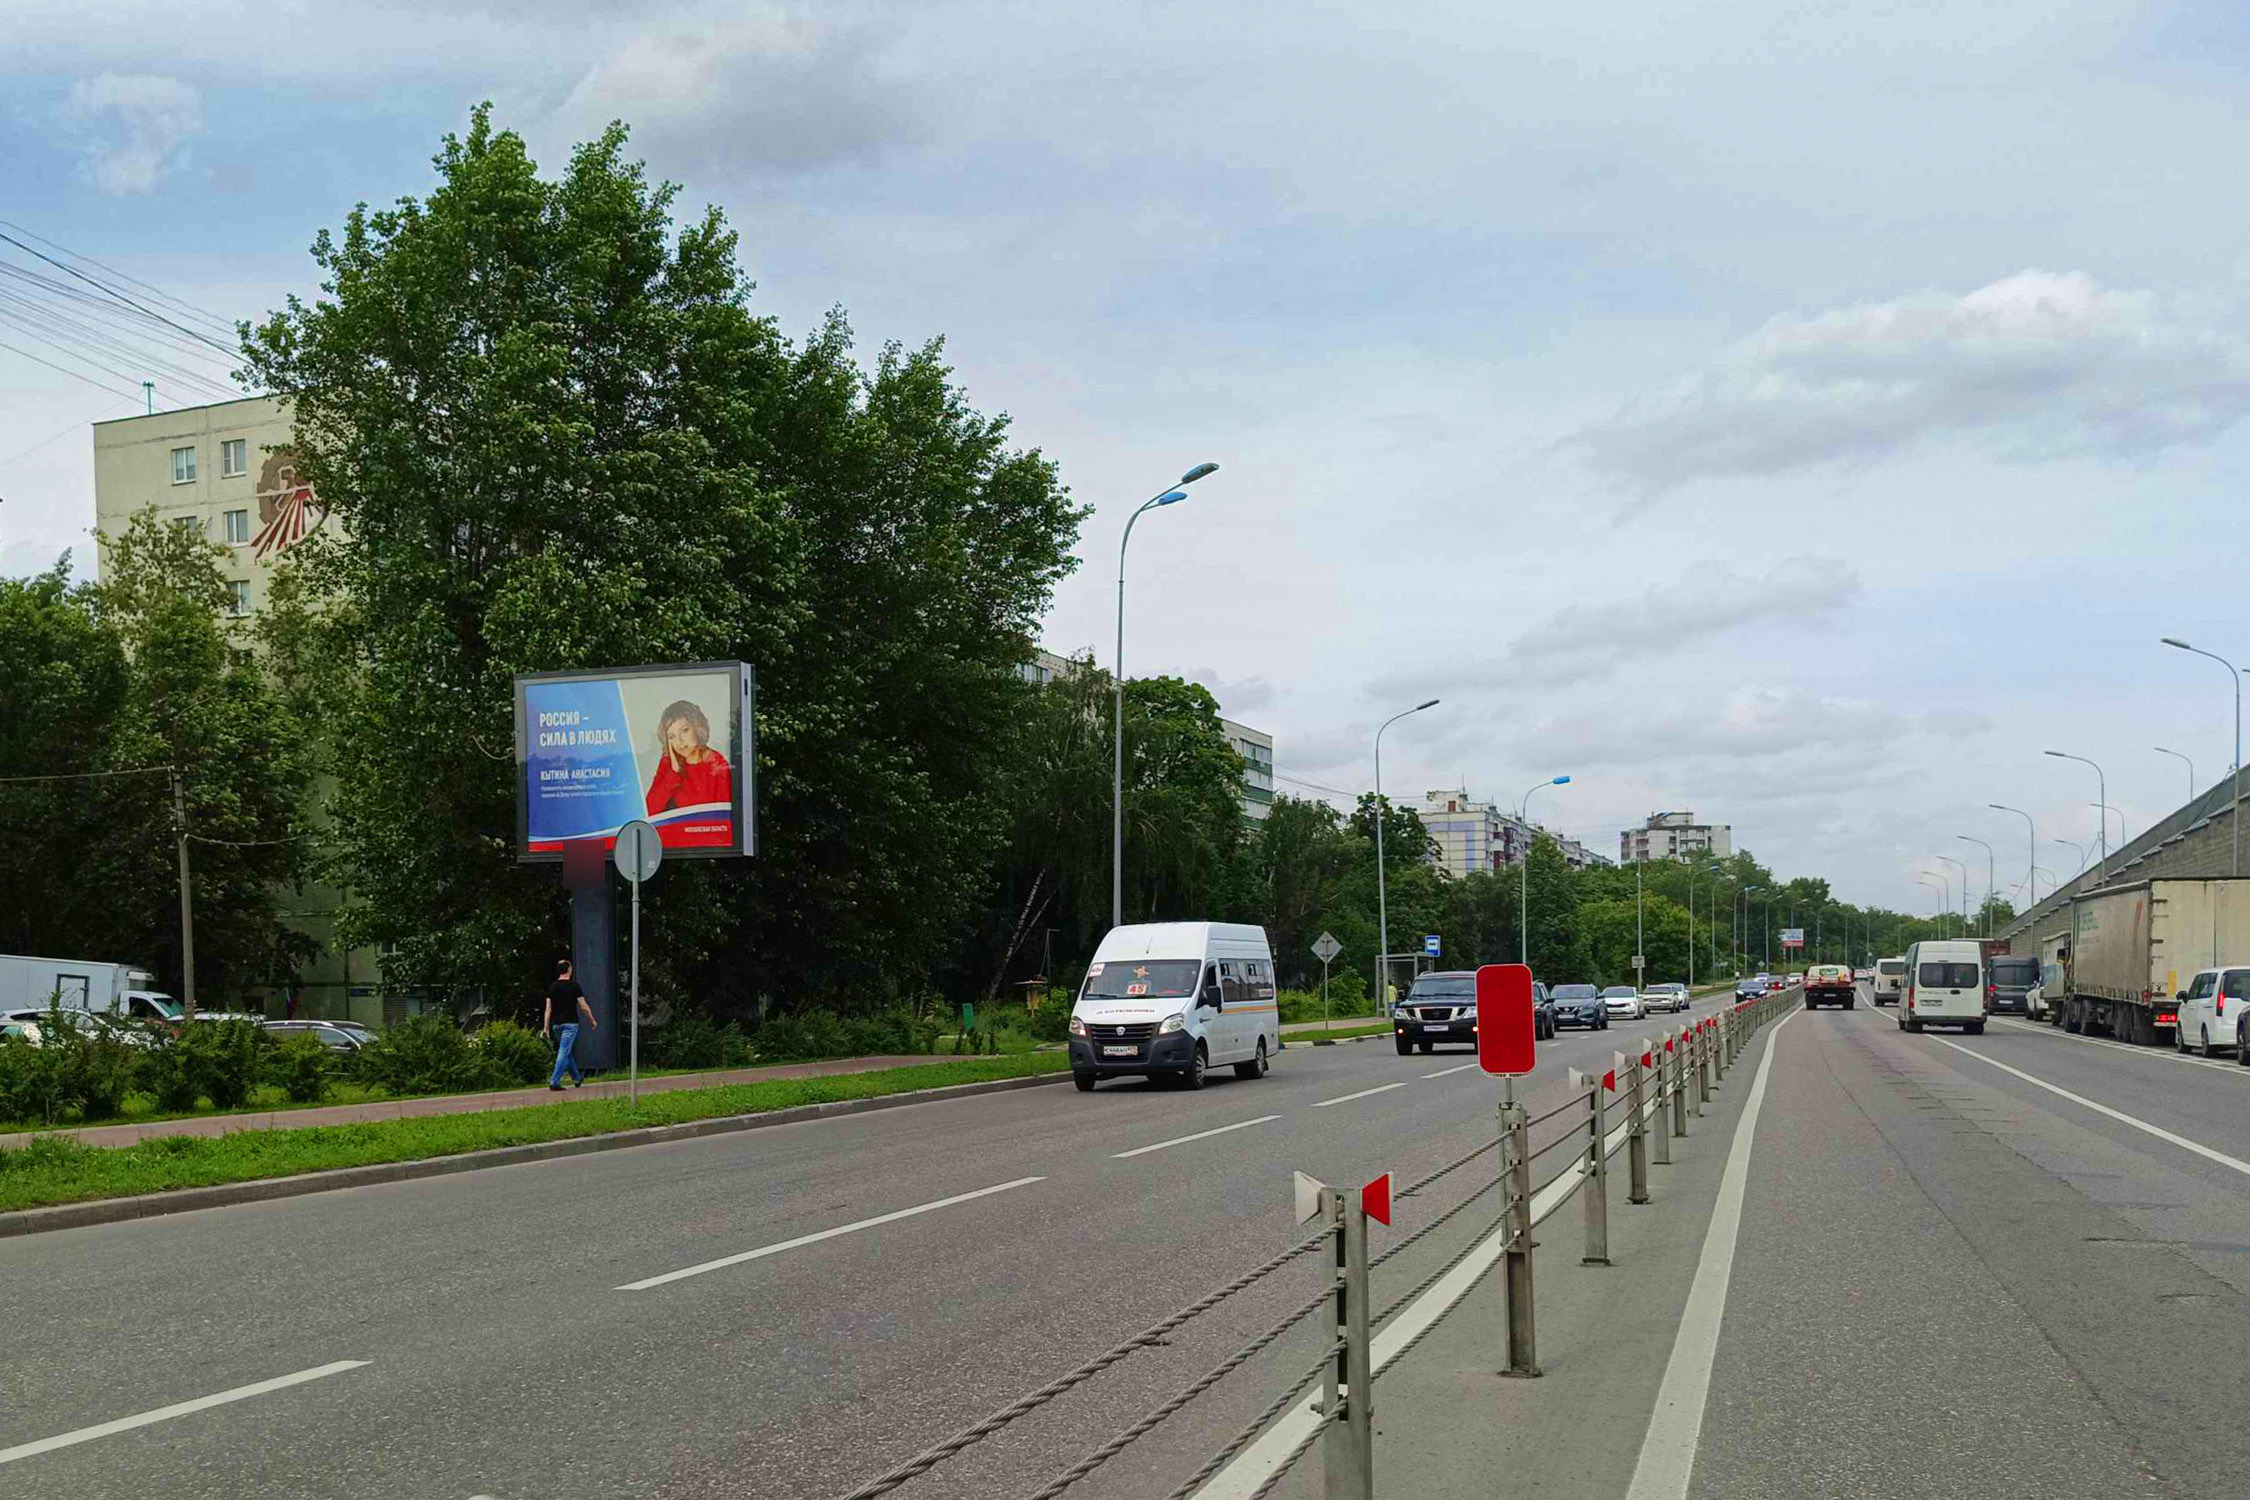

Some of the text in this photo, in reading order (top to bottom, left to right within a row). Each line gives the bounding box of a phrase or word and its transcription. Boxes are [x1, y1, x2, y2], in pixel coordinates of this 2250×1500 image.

[540, 711, 579, 727] РОССИЯ
[540, 729, 616, 747] СИЛА В ЛЮДЯХ
[571, 768, 610, 779] АНАСТАСИЯ
[1129, 984, 1145, 993] 45
